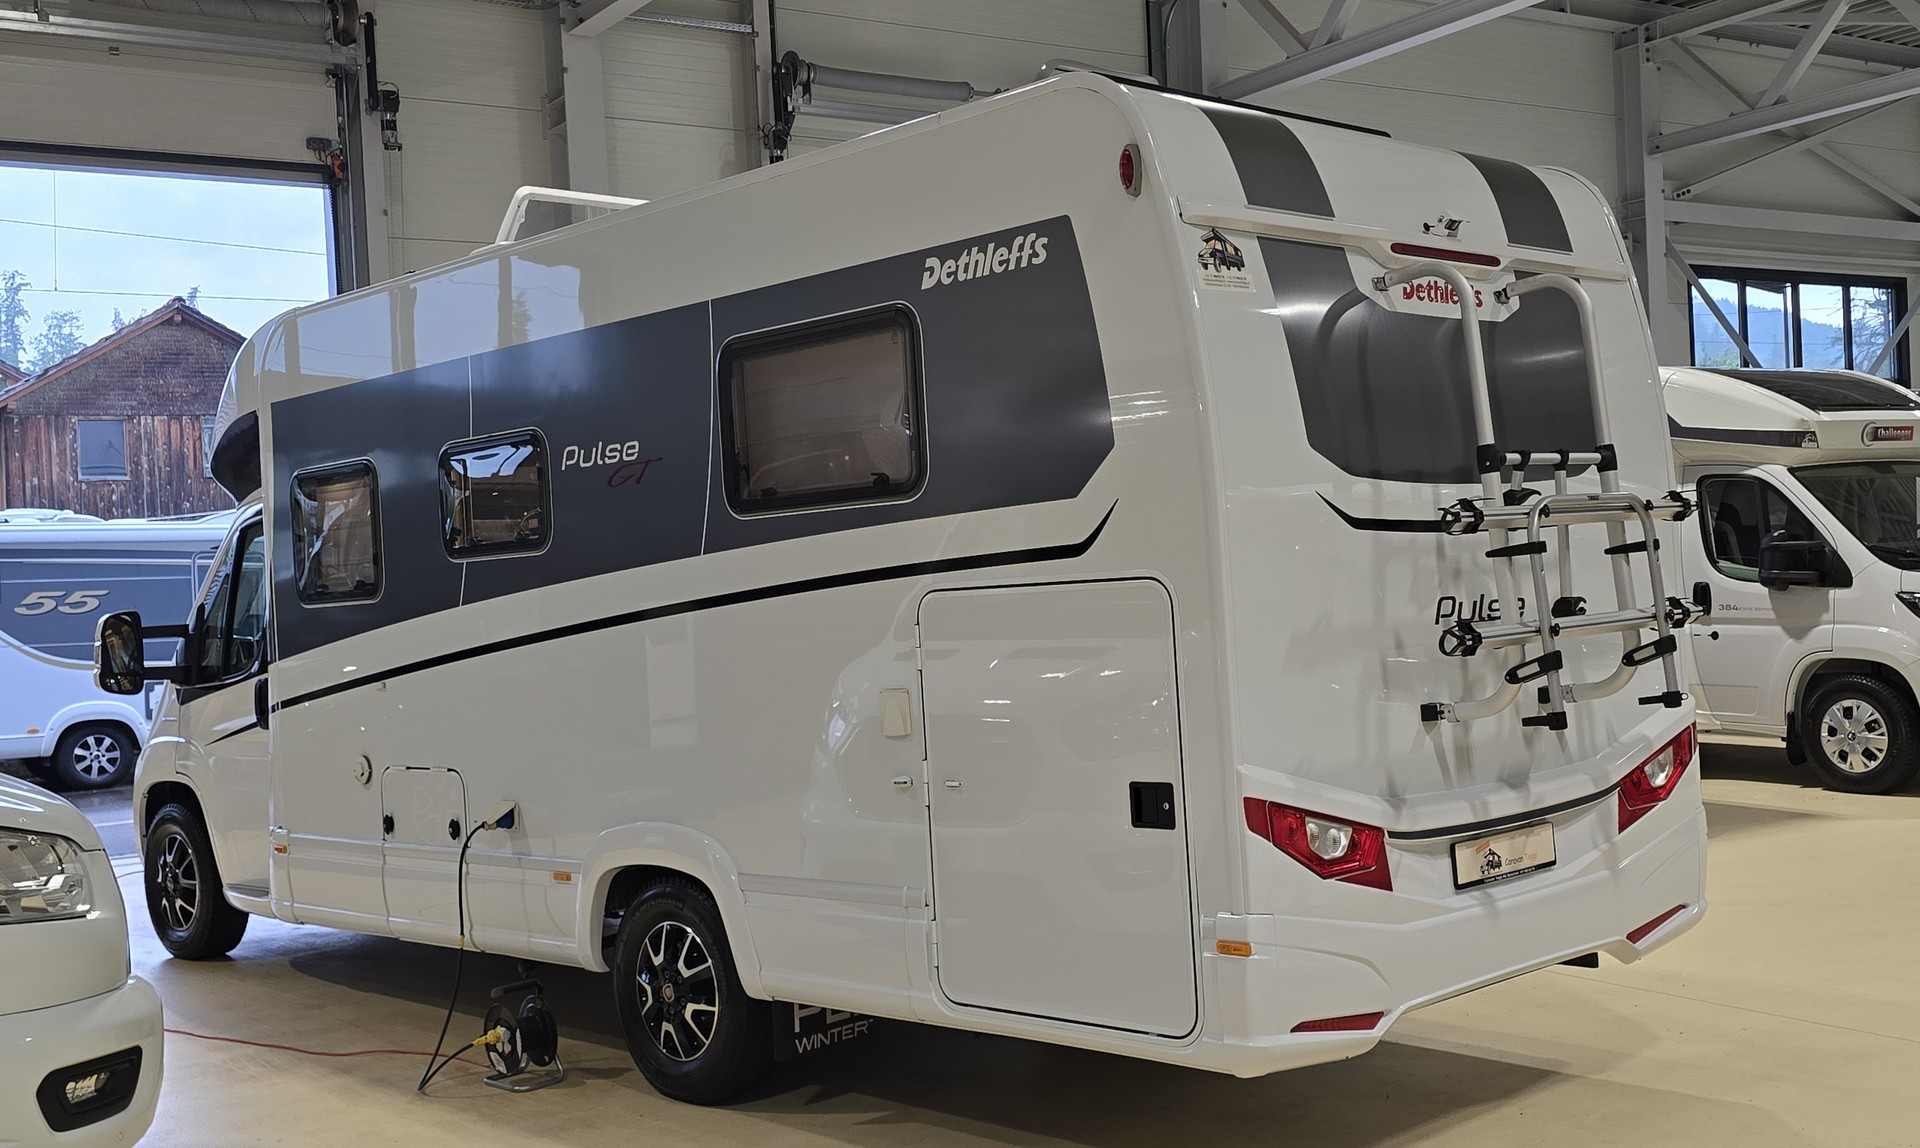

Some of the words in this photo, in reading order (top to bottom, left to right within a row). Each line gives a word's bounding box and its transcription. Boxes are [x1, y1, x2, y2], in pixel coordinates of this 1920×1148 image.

[921, 233, 1048, 290] Dethleffs
[1403, 280, 1483, 308] Dethles
[1877, 427, 1911, 440] Challenger
[561, 441, 639, 470] Pulse
[607, 457, 663, 488] GT
[13, 590, 109, 615] 55
[795, 1020, 869, 1054] WINTER
